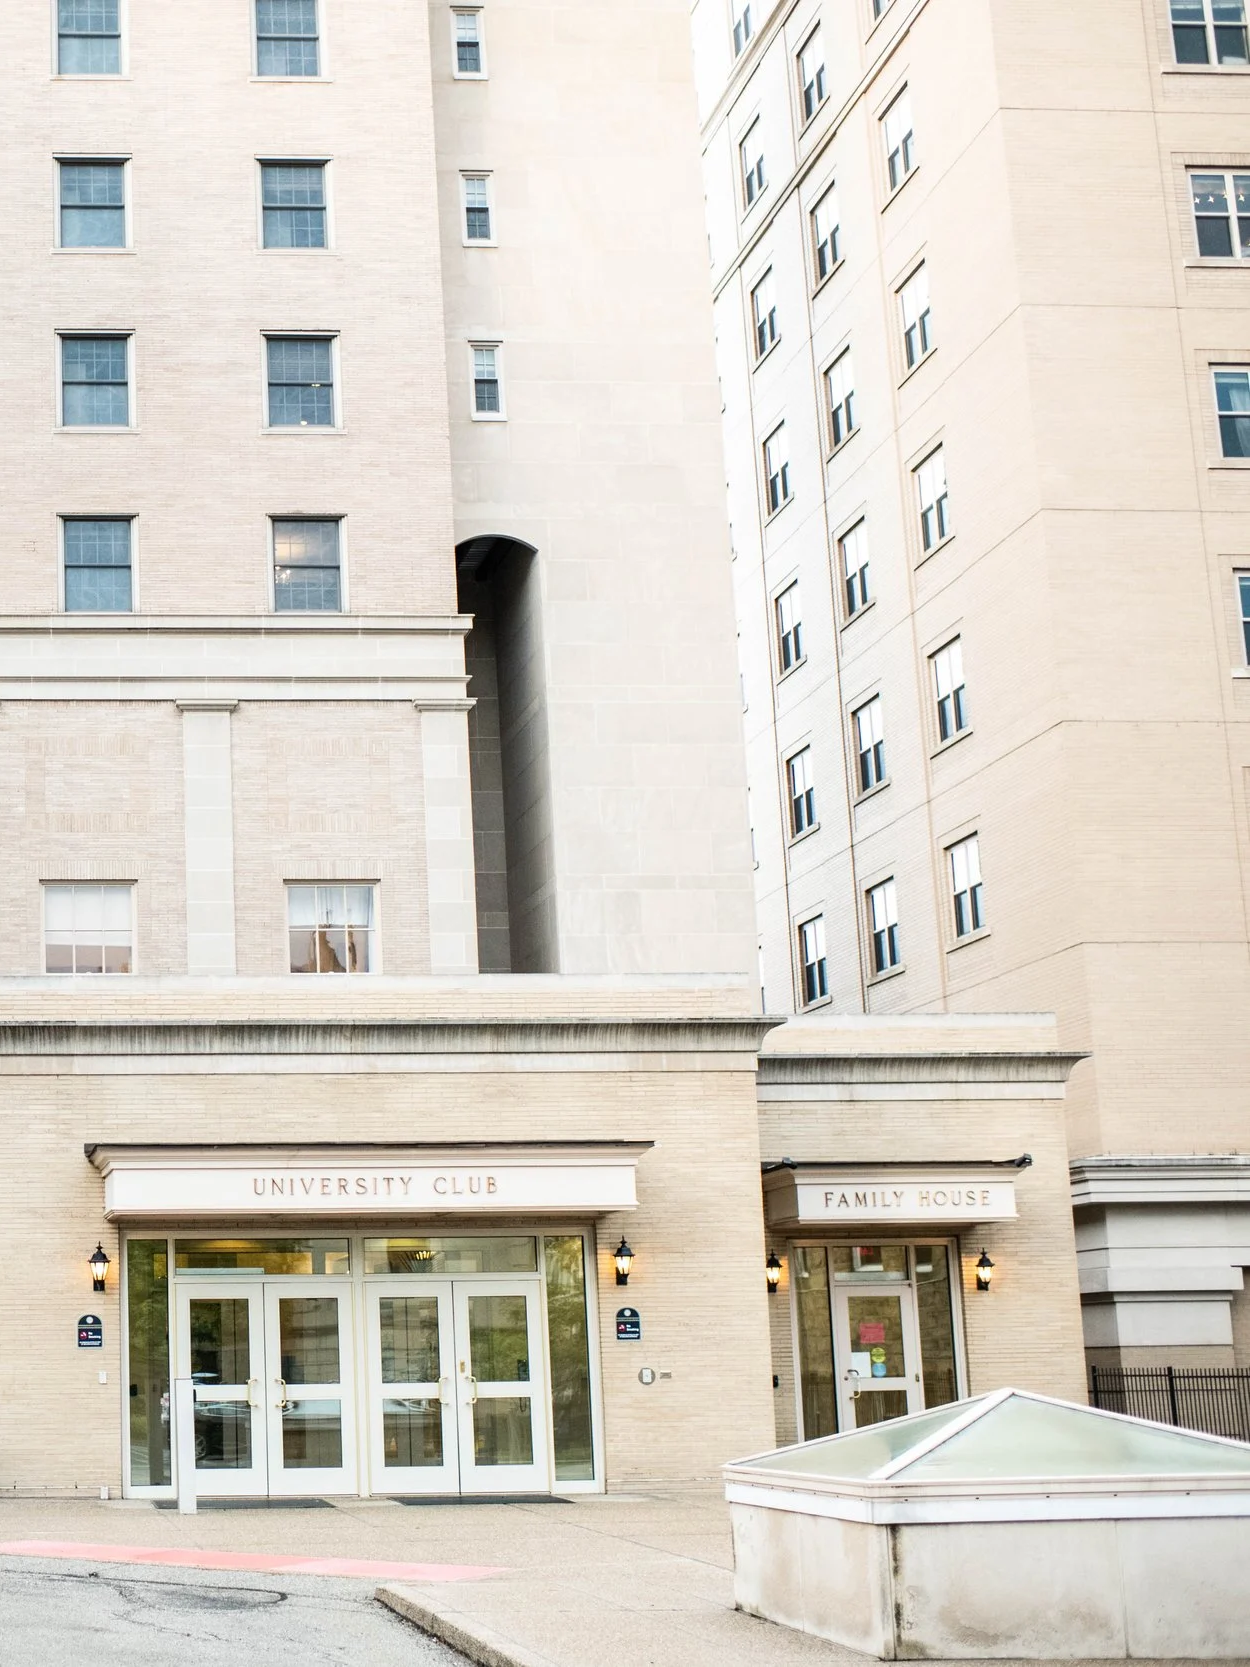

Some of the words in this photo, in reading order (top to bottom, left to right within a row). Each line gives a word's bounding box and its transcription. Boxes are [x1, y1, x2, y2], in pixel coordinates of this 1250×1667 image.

[252, 1177, 412, 1196] UNIVERSITY
[433, 1176, 498, 1195] CLUB
[824, 1191, 904, 1208] FAMILY
[918, 1190, 992, 1207] HOUSE
